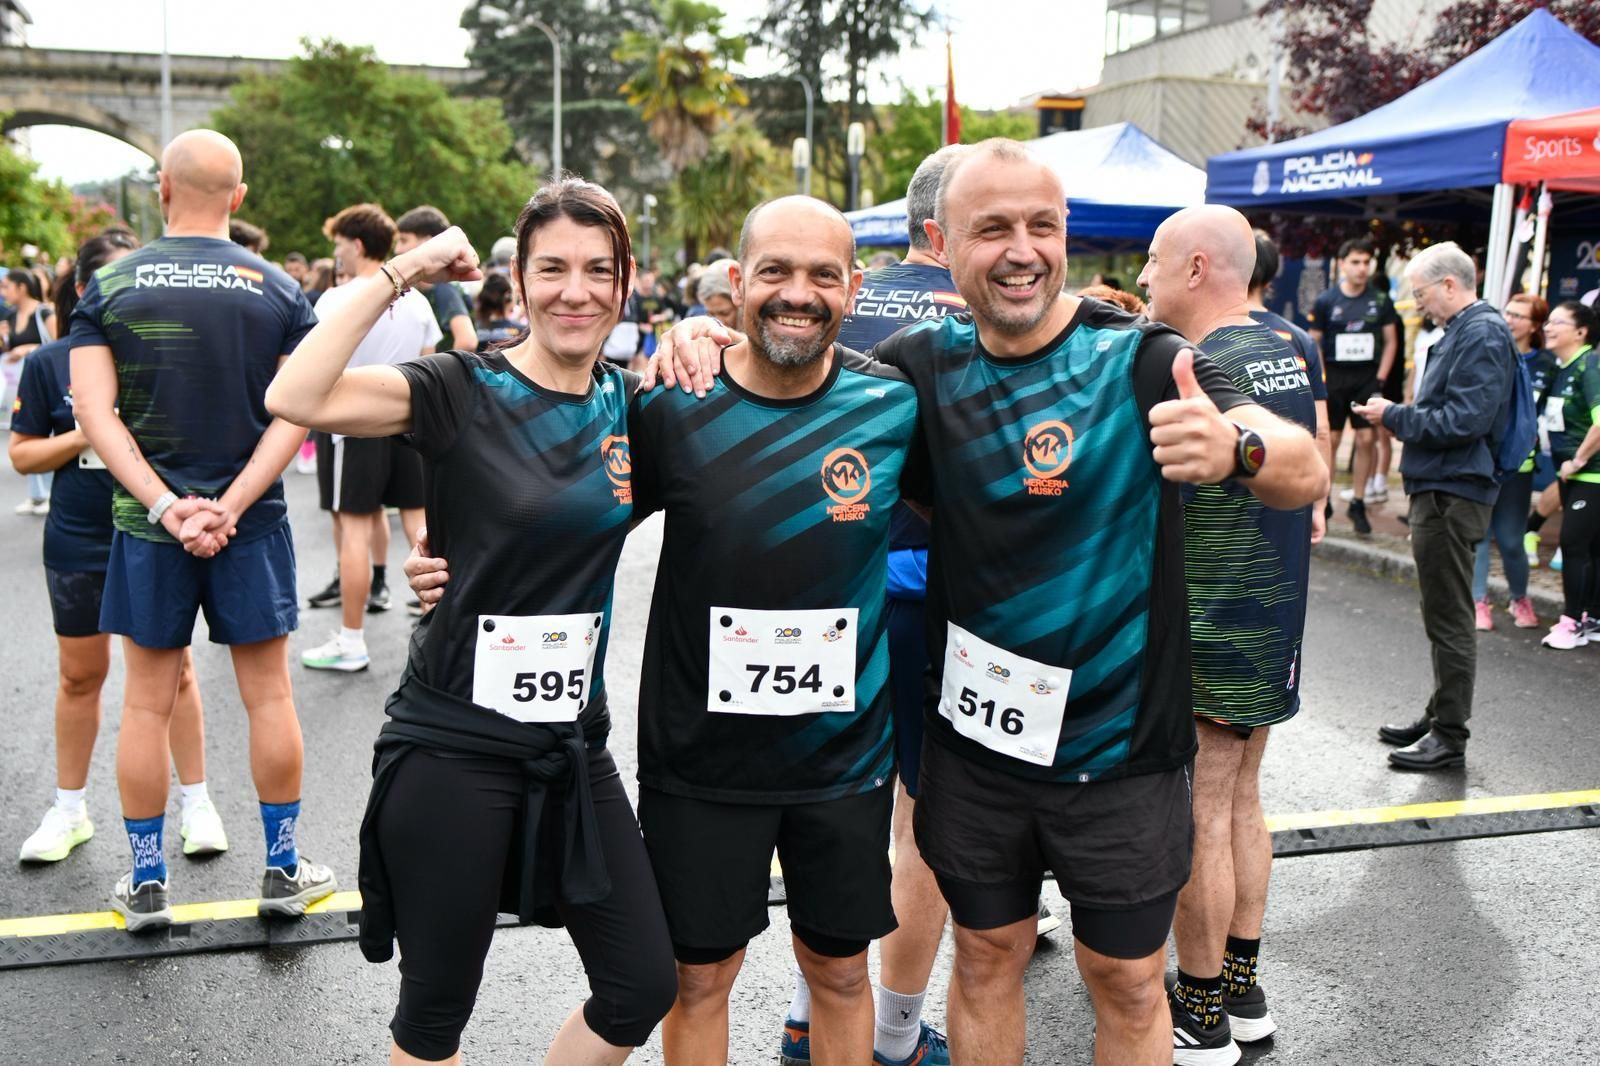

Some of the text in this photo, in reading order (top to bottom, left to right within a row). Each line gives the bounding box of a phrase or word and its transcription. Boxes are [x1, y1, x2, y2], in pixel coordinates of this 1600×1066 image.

[1524, 135, 1582, 164] Sports
[1280, 168, 1383, 194] NACIONAL
[135, 263, 240, 278] POLICIA
[135, 274, 264, 296] NACIONAL
[855, 287, 934, 304] OLICIA
[852, 303, 948, 320] CIONAL
[1023, 478, 1069, 488] MERCERIA
[1028, 486, 1062, 496] MUSKO
[826, 504, 870, 514] MERCERIA
[833, 512, 865, 522] MUSKO
[722, 635, 759, 644] Santander
[489, 643, 526, 652] Santander
[745, 664, 823, 695] 754
[512, 669, 584, 703] 595
[957, 686, 1025, 736] 516
[1231, 962, 1250, 974] PAI
[1186, 985, 1207, 997] PAI
[1205, 995, 1223, 1004] PAI
[1186, 1002, 1207, 1014] PAI
